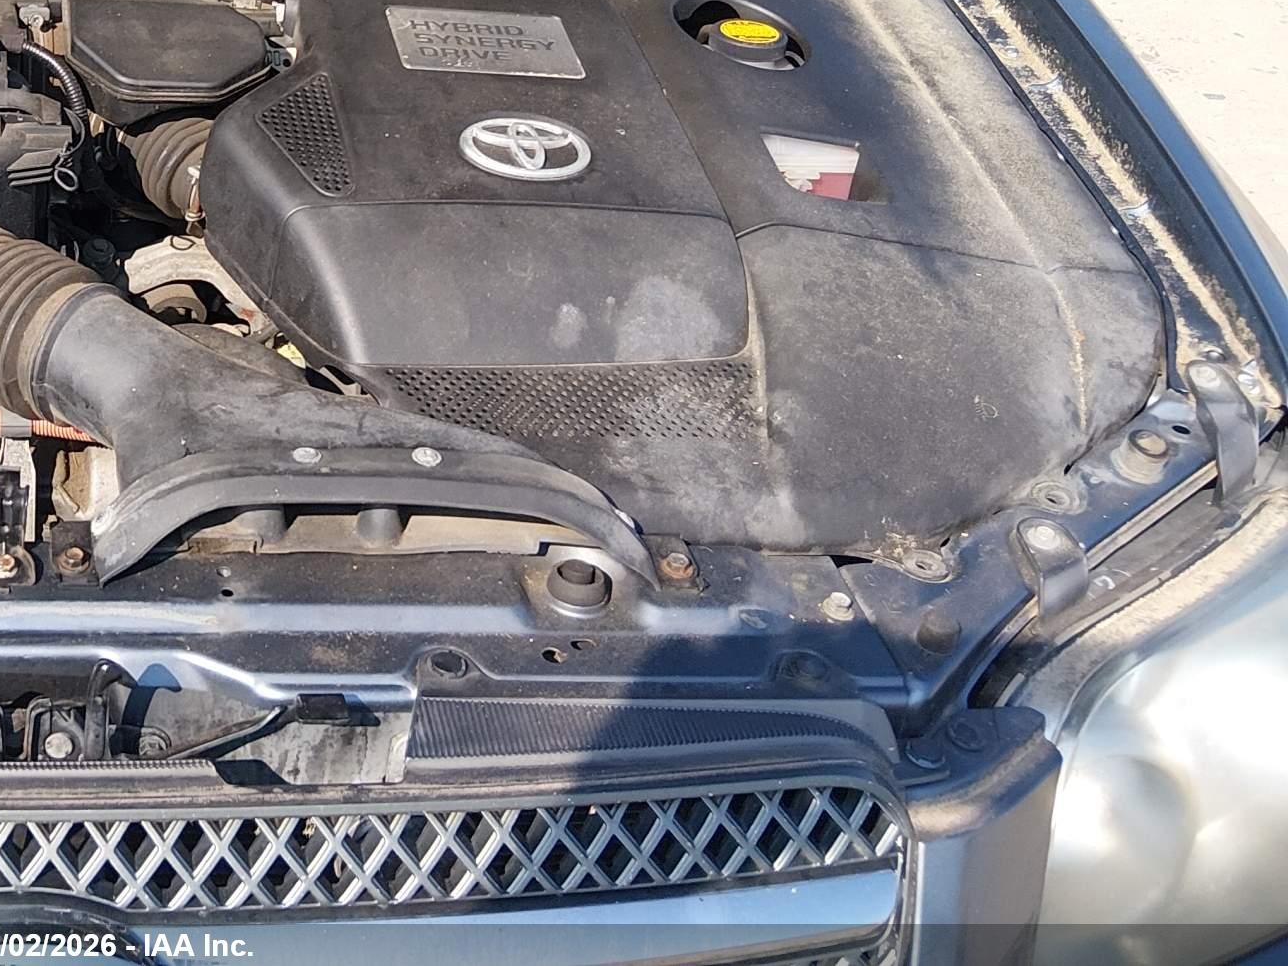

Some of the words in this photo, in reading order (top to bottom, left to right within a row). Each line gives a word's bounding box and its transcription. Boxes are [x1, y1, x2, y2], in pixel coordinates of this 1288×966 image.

[410, 20, 524, 35] HYBRID
[414, 34, 555, 51] SYNERGY
[419, 46, 511, 61] DRIVE
